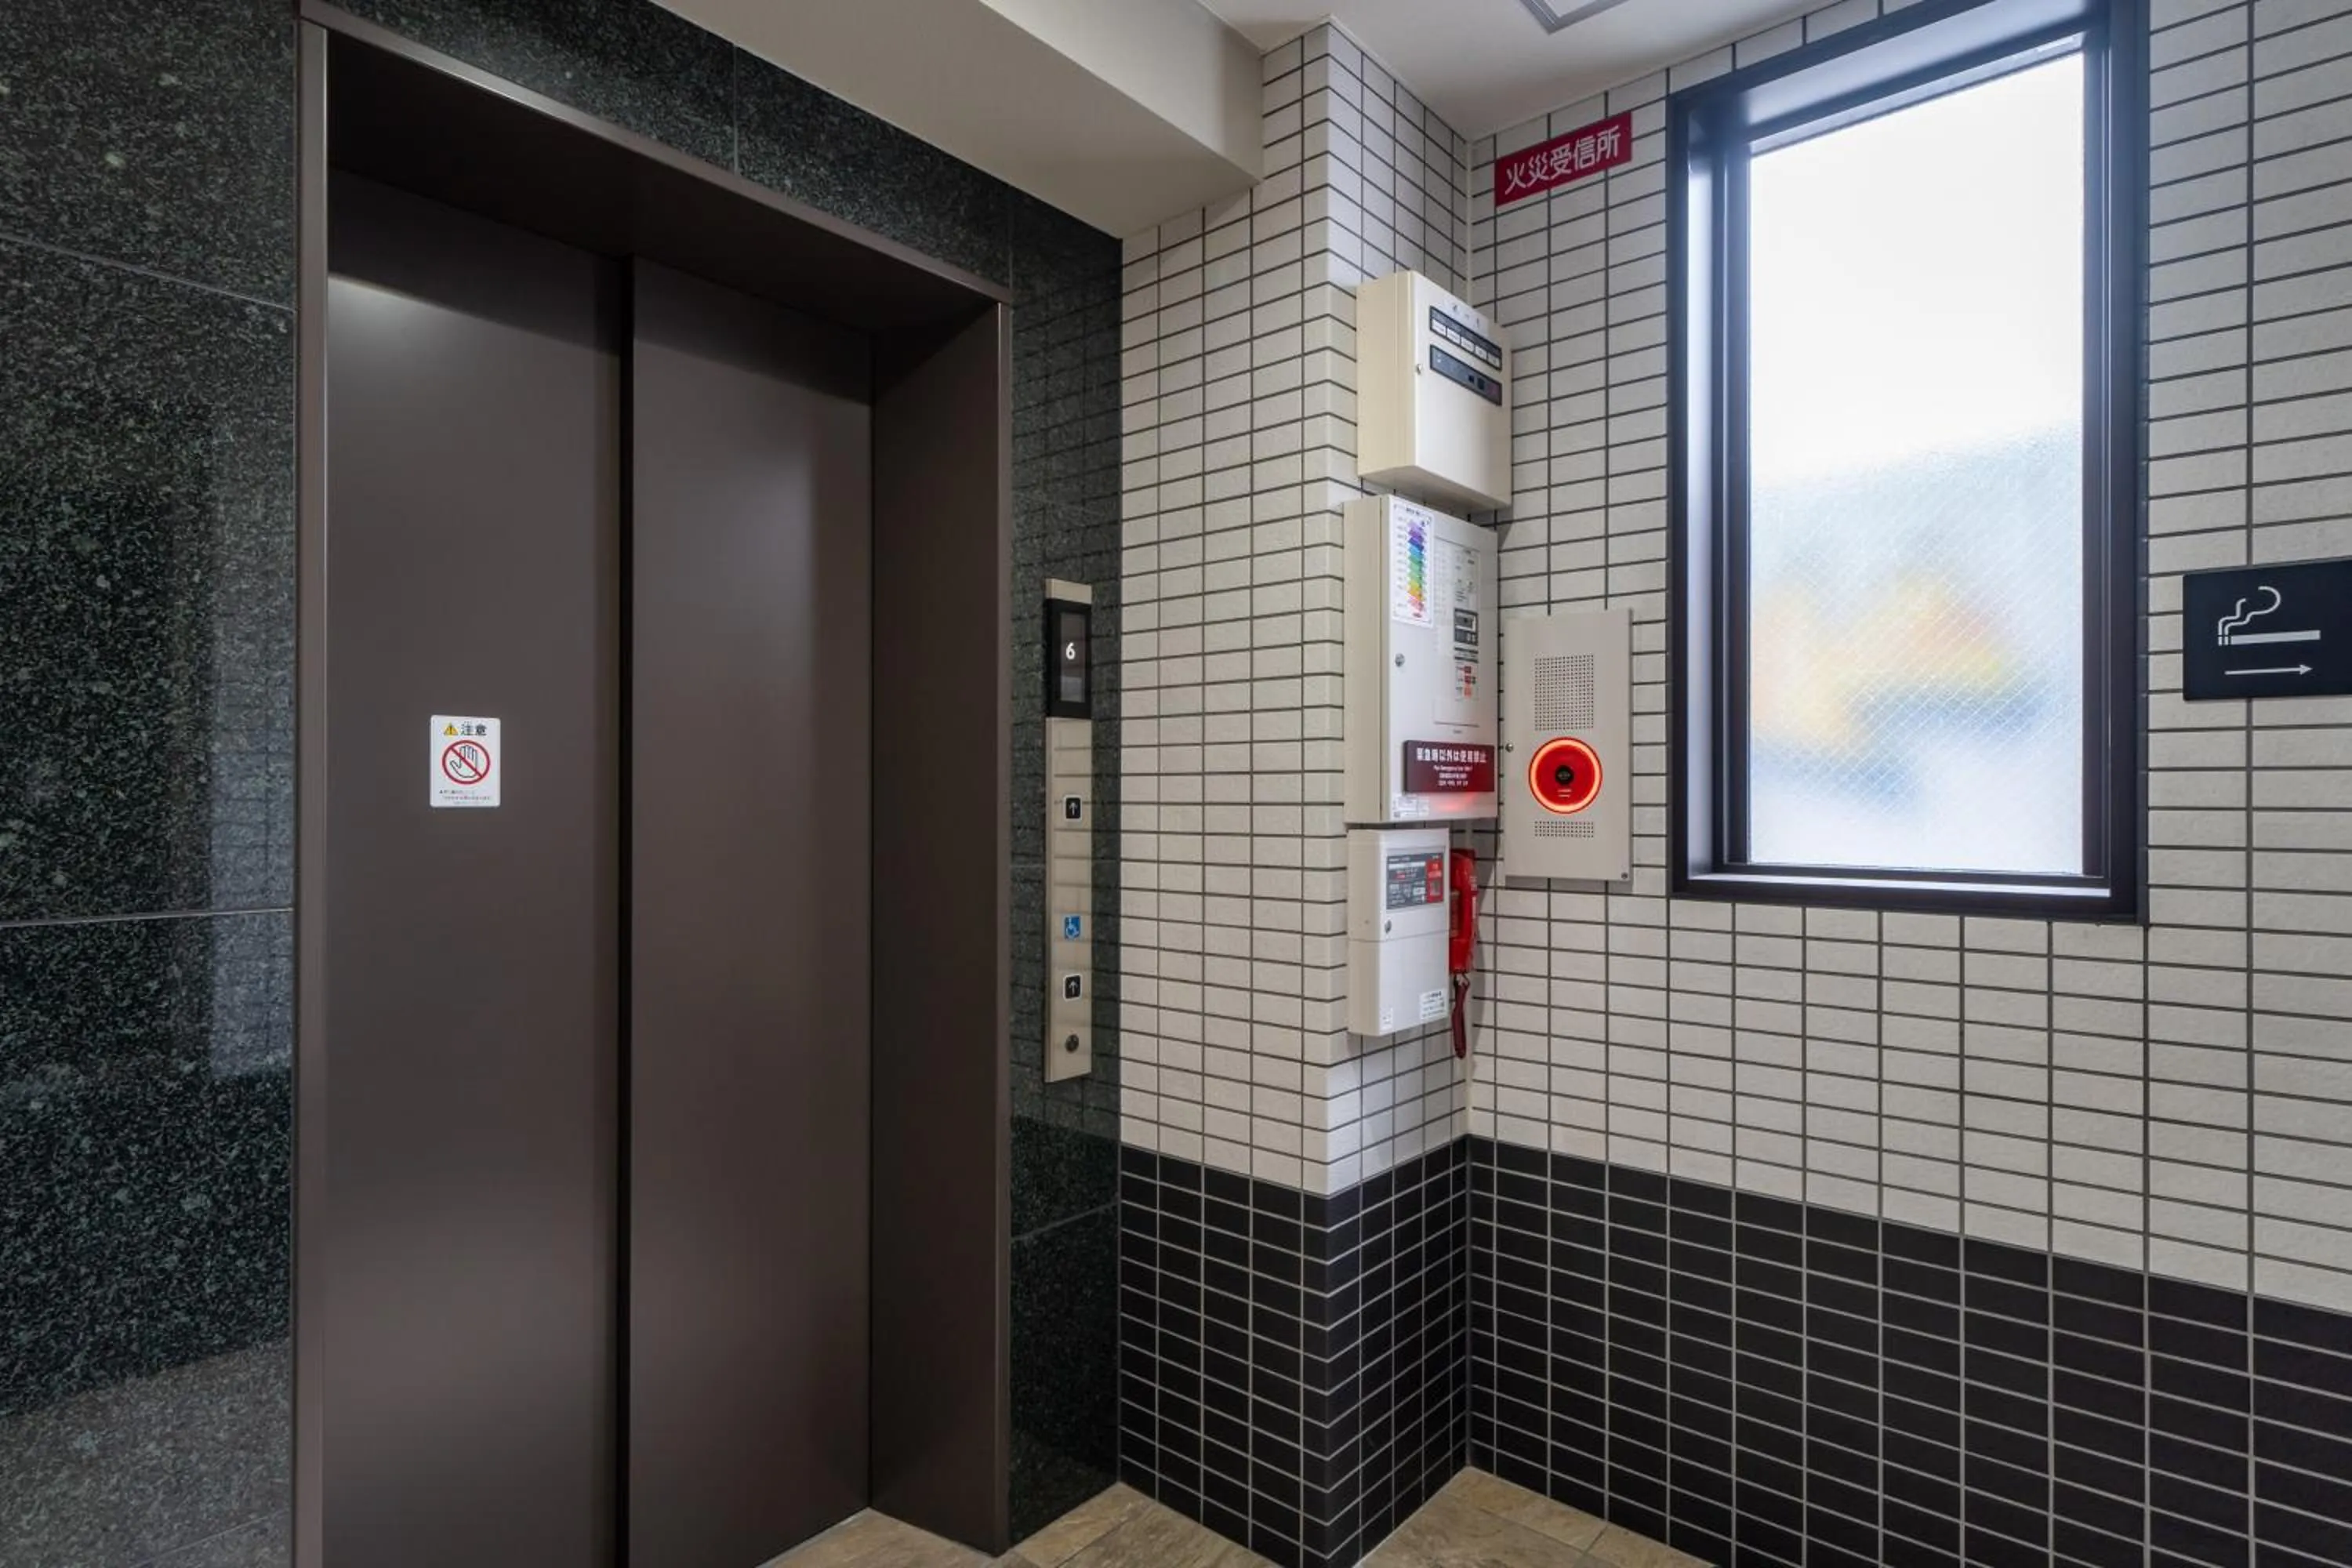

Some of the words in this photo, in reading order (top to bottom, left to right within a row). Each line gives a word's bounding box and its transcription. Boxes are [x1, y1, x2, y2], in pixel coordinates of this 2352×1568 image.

[1504, 125, 1621, 194] 火災受信所
[1066, 642, 1075, 659] 6
[461, 721, 487, 735] 注意
